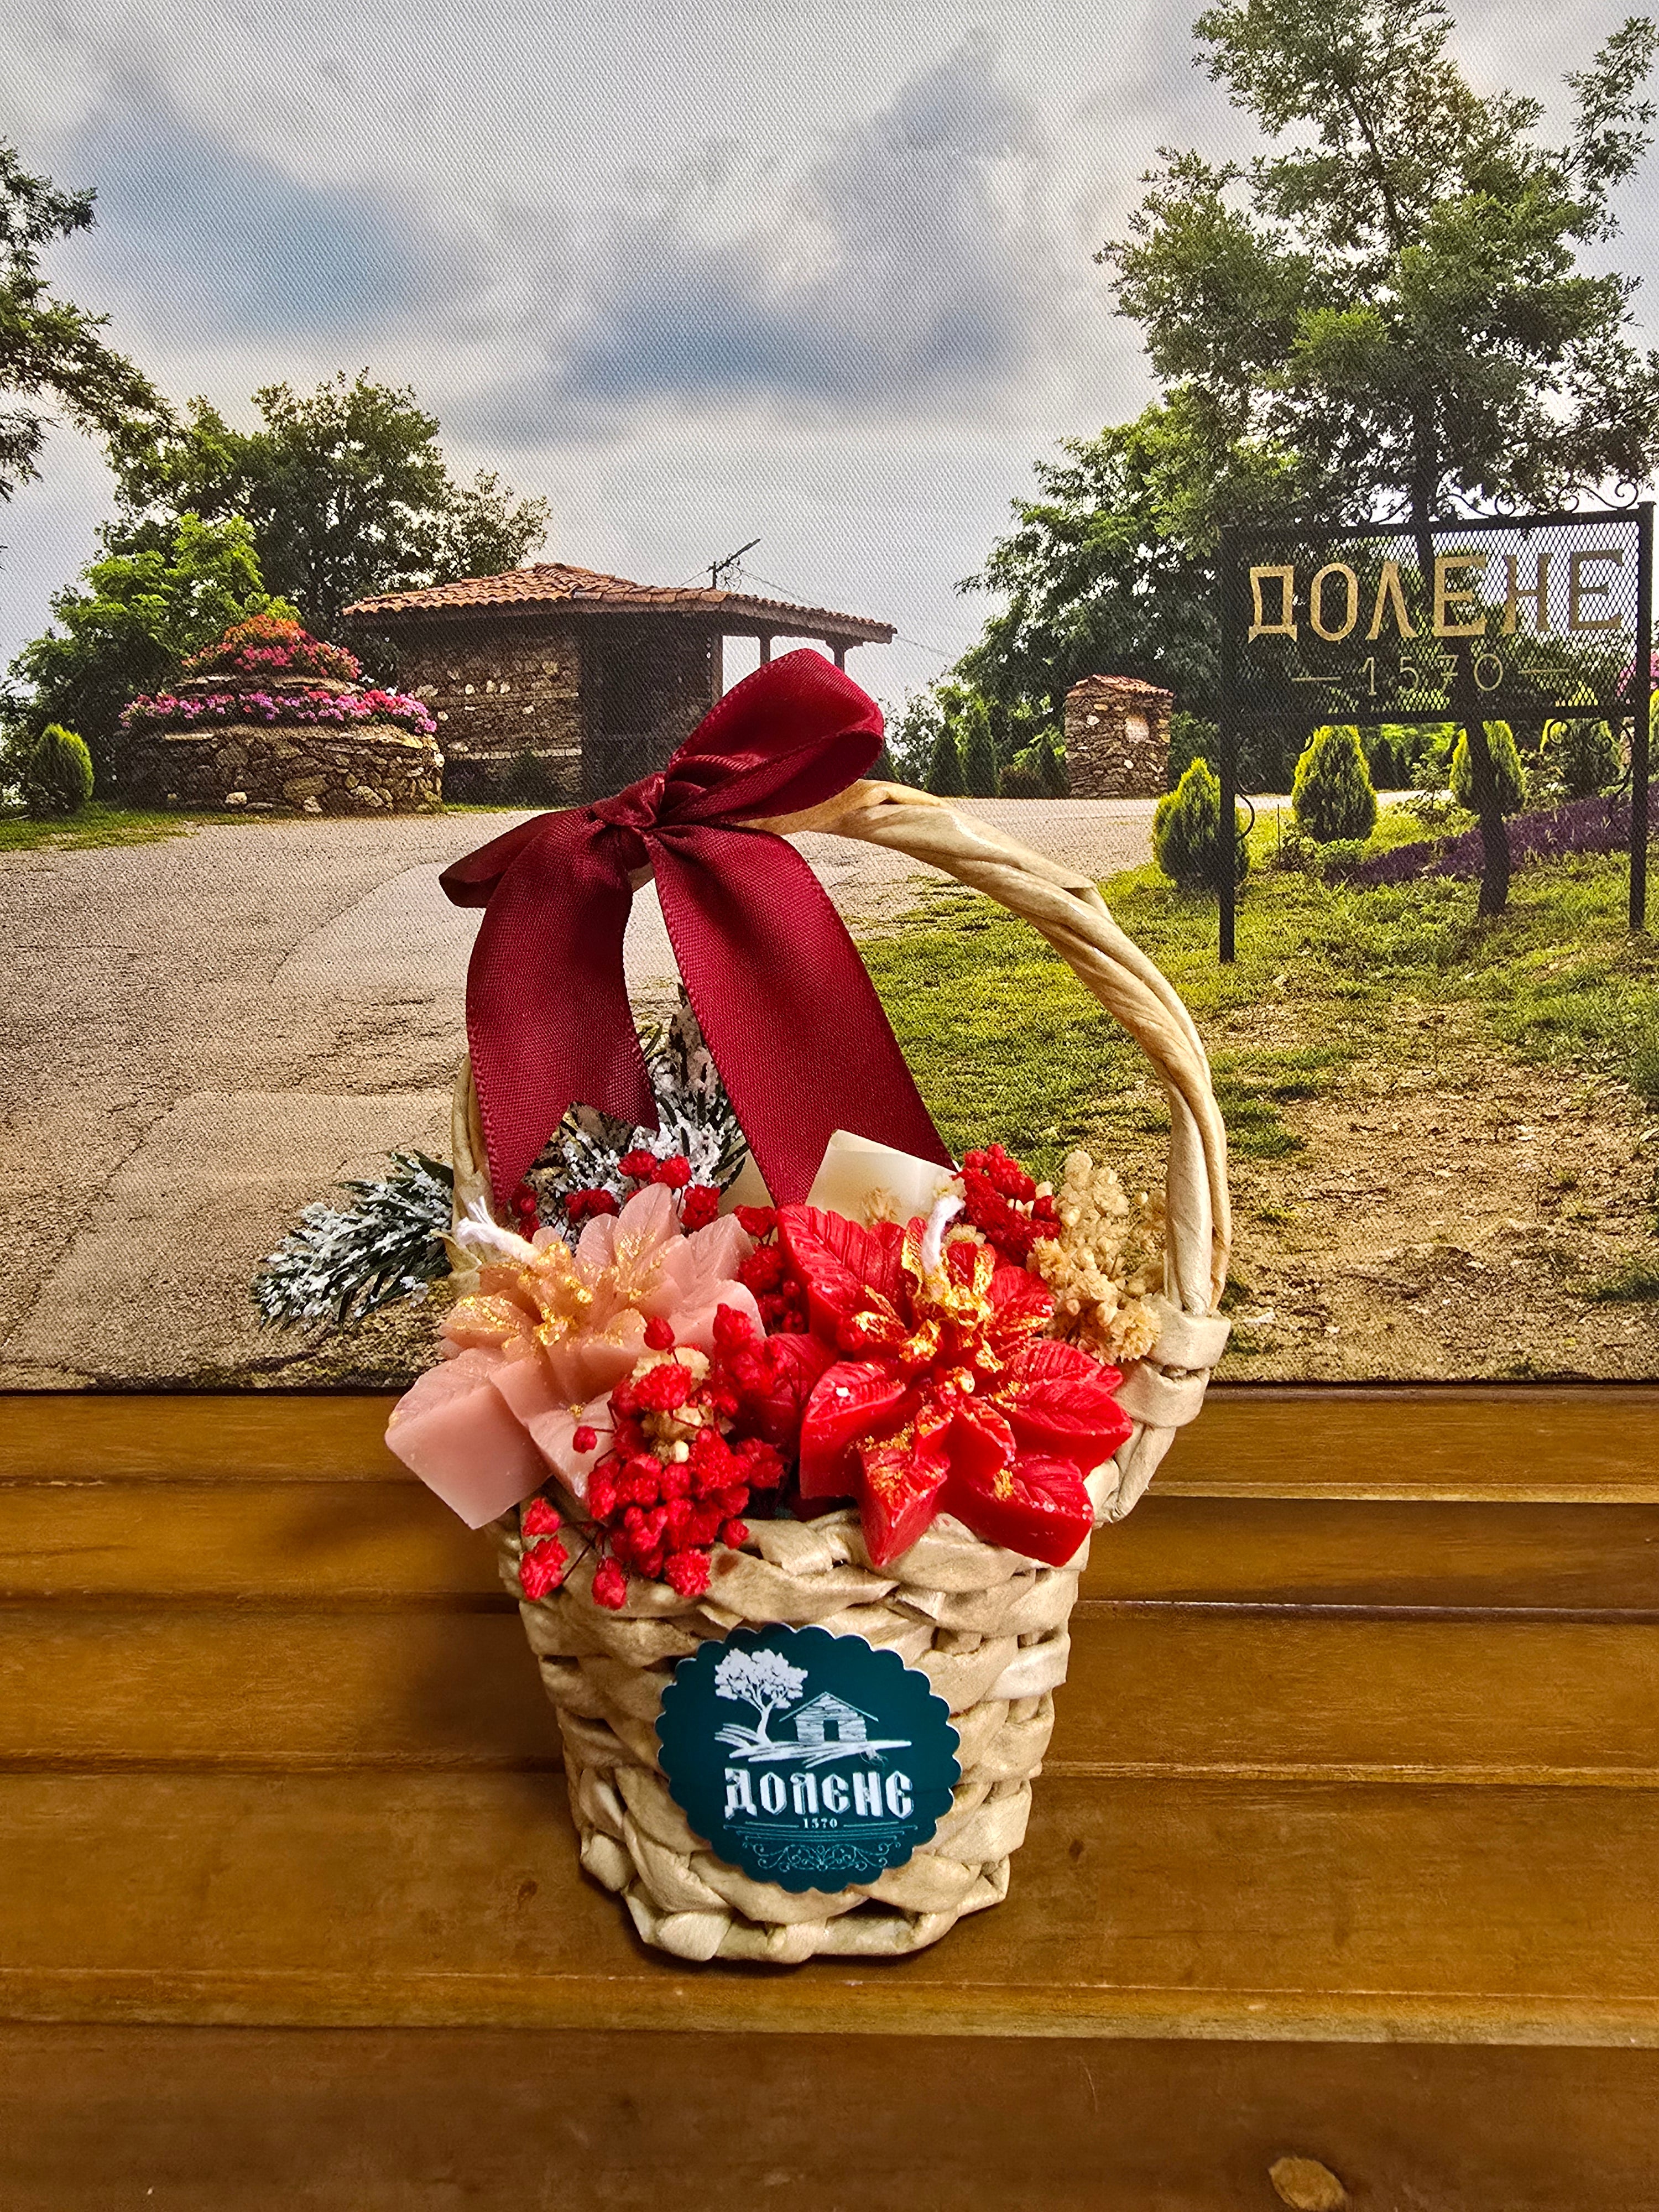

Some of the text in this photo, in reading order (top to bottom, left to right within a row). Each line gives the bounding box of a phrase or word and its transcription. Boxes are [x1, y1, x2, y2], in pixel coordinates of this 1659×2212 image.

[1248, 550, 1623, 643] ДОЛЕНЕ
[1362, 653, 1504, 697] 1570
[804, 1818, 838, 1829] 1570
